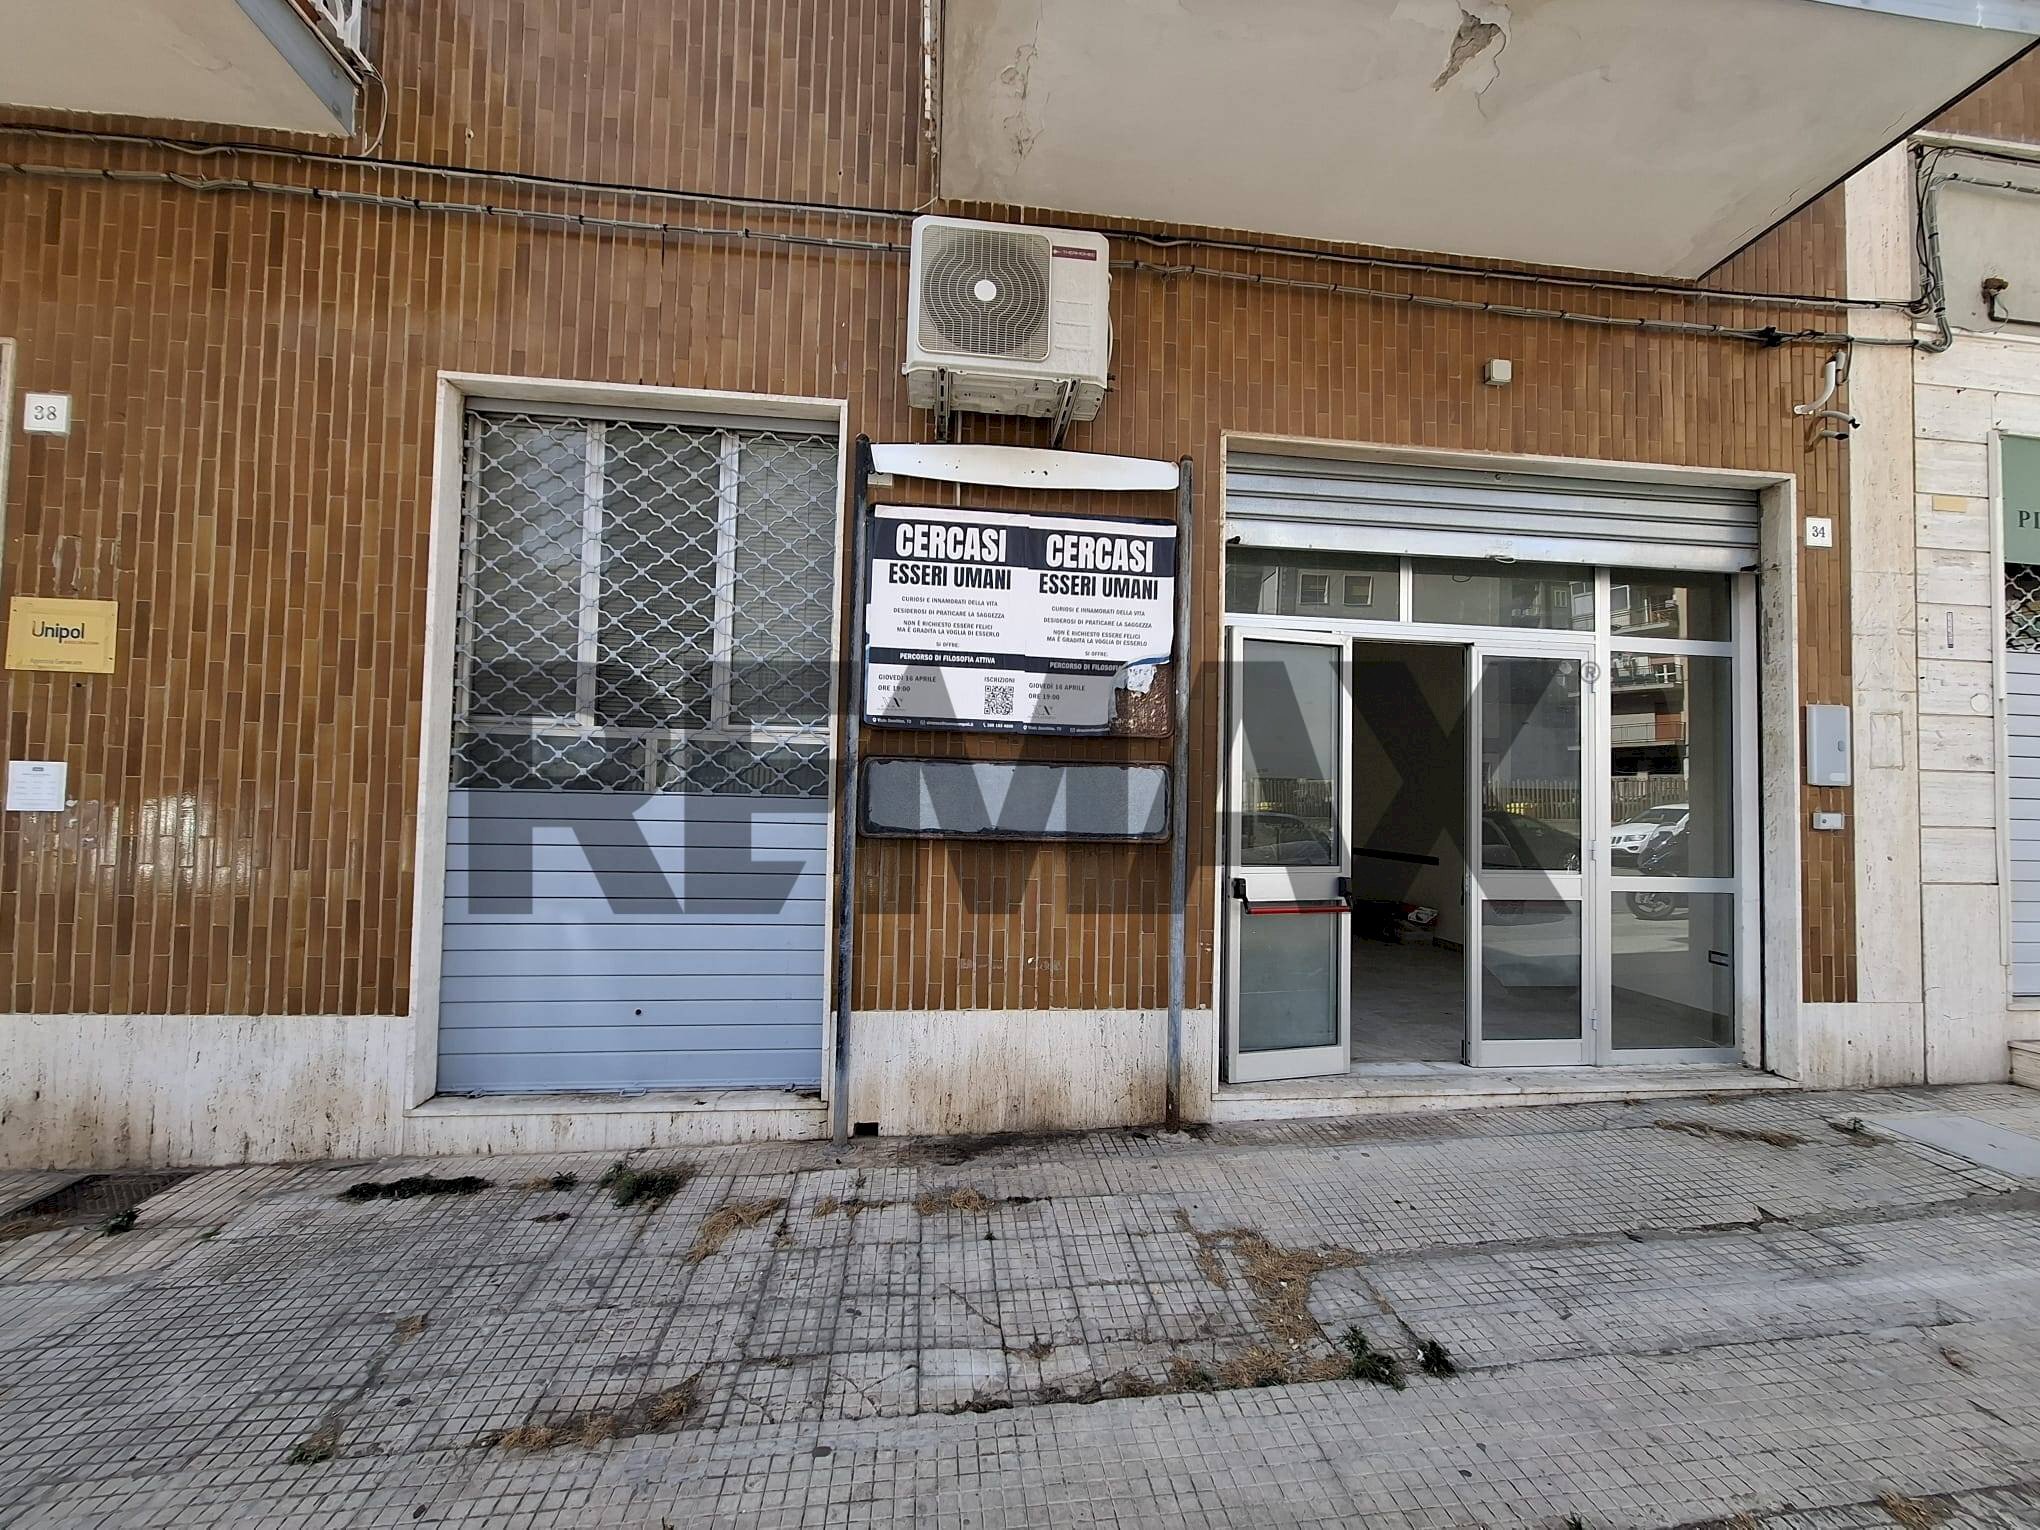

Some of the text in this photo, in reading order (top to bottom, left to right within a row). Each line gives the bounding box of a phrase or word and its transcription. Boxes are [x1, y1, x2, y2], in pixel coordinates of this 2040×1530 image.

[34, 405, 57, 421] 38
[1812, 525, 1826, 538] 34
[895, 523, 1007, 563] CERCASI
[1046, 534, 1154, 573] CERCASI
[889, 562, 1012, 590] ESSERI UMANI
[1039, 573, 1158, 600] ESSERI UMANI
[931, 597, 966, 605] INNAMORATI
[936, 609, 966, 617] PRATICARE
[1080, 607, 1115, 615] INNAMORATI
[1043, 617, 1076, 625] DESIDEROSI
[1085, 619, 1114, 627] PRATICARE
[1124, 621, 1152, 629] SAGGEZZA
[32, 620, 85, 644] Unipol
[1062, 636, 1086, 644] GRADITA
[899, 652, 933, 661] PERCORSO
[943, 655, 974, 663] FILOSOFIA
[975, 656, 996, 664] ATTIVA
[1049, 661, 1082, 670] PERCORSO
[1083, 663, 1091, 671] DI
